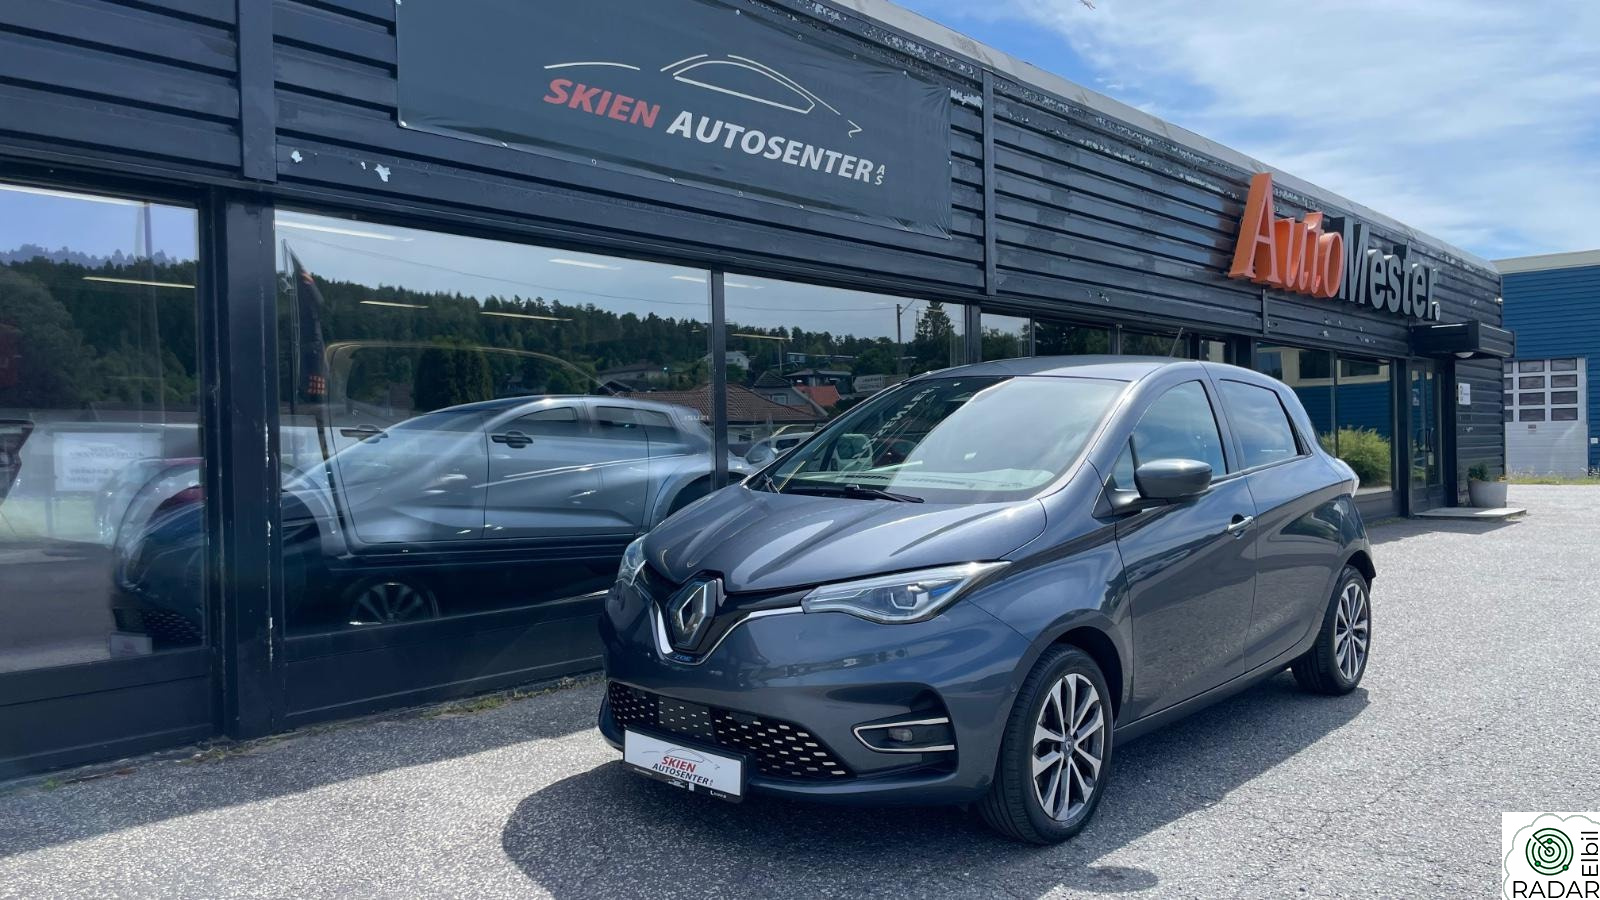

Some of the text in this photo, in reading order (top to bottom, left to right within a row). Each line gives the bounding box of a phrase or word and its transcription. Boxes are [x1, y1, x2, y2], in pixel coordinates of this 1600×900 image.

[544, 78, 661, 128] SKIEN
[666, 111, 873, 183] AUTOSENTER
[652, 763, 709, 785] AUTOSENTER
[661, 756, 697, 773] SKIEN
